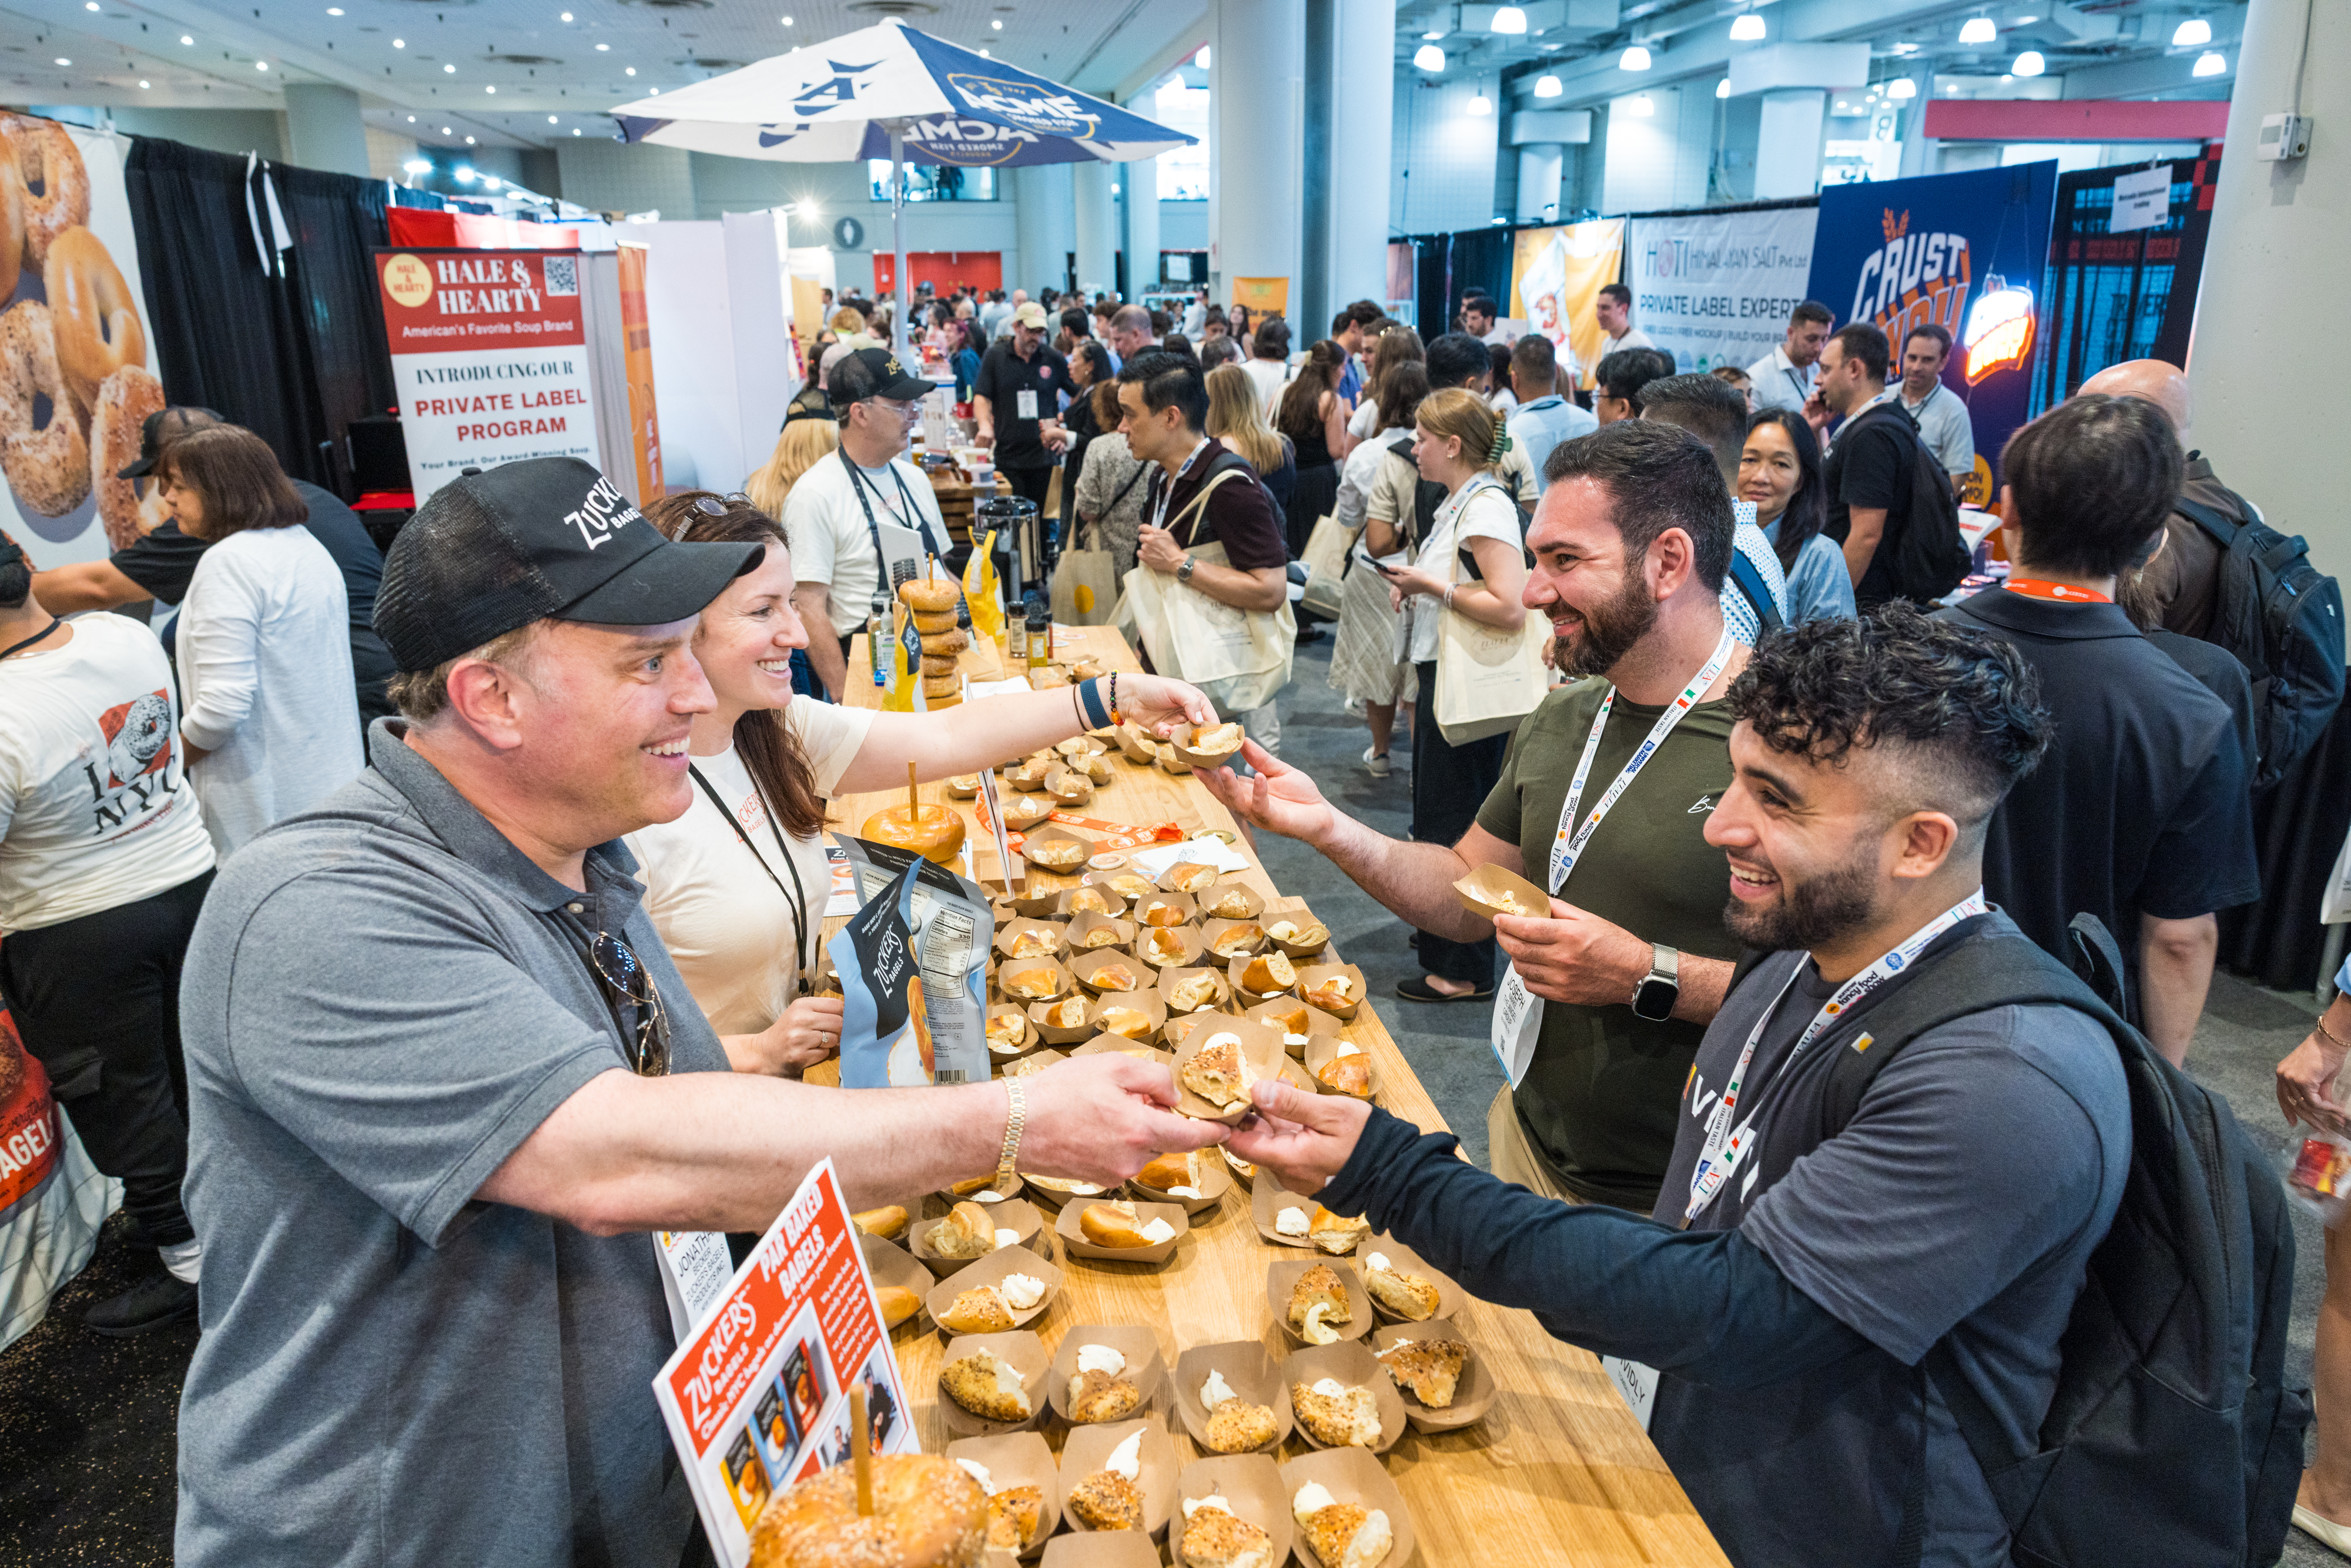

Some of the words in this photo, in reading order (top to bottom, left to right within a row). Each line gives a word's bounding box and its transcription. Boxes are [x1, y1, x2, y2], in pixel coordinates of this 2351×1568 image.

[955, 85, 1101, 123] ACME
[437, 259, 507, 284] HALE
[511, 259, 531, 289] &
[1850, 232, 1967, 324] CRUST
[437, 288, 541, 314] HEARTY
[1640, 295, 1688, 315] PRIVATE
[1692, 296, 1736, 317] LABEL
[468, 323, 512, 335] Favorite
[514, 321, 542, 334] Soup
[543, 319, 574, 332] Brand
[416, 362, 537, 384] INTRODUCING
[541, 360, 574, 376] OUR
[415, 394, 514, 417] PRIVATE
[521, 388, 587, 408] LABEL
[457, 417, 567, 441] PROGRAM
[1665, 705, 1677, 722] ITALIAN
[1655, 720, 1665, 733] TASTE
[1625, 749, 1645, 774] MARKETING
[1630, 752, 1649, 773] UNIVERSAL
[93, 754, 178, 836] NYC
[1605, 779, 1626, 808] ITALIA
[748, 816, 765, 833] BAGELS
[1562, 812, 1571, 829] fancy
[1580, 821, 1594, 837] fancy
[870, 848, 888, 858] STARTED
[1569, 835, 1580, 850] show
[1572, 836, 1583, 851] food
[940, 910, 957, 919] Nutrition
[958, 916, 972, 924] Facts
[932, 926, 948, 934] Calories
[889, 956, 904, 983] BAGELS
[1507, 976, 1526, 1010] JOSEPH
[1837, 985, 1861, 1006] fancy
[1858, 970, 1878, 990] food
[1837, 981, 1858, 1000] summer
[1864, 975, 1886, 993] show
[1503, 1007, 1512, 1024] GROUP
[1508, 1004, 1516, 1023] ANGEL
[1714, 1108, 1726, 1132] ITALIAN
[0, 1110, 54, 1182] AGEL
[1707, 1130, 1718, 1148] TASTE
[760, 1232, 789, 1284] PAR
[784, 1182, 823, 1248] BAKED
[678, 1231, 716, 1278] JONATHA
[692, 1247, 712, 1276] BECKER
[707, 1244, 725, 1271] BAGELS
[778, 1224, 825, 1301] BAGELS
[692, 1271, 716, 1310] PRODUCTS
[726, 1372, 746, 1404] NYC
[743, 1346, 766, 1379] bagels
[764, 1333, 775, 1349] on
[773, 1295, 798, 1336] demand
[799, 1273, 816, 1295] from
[814, 1255, 829, 1281] your
[714, 1342, 749, 1395] BAGELS
